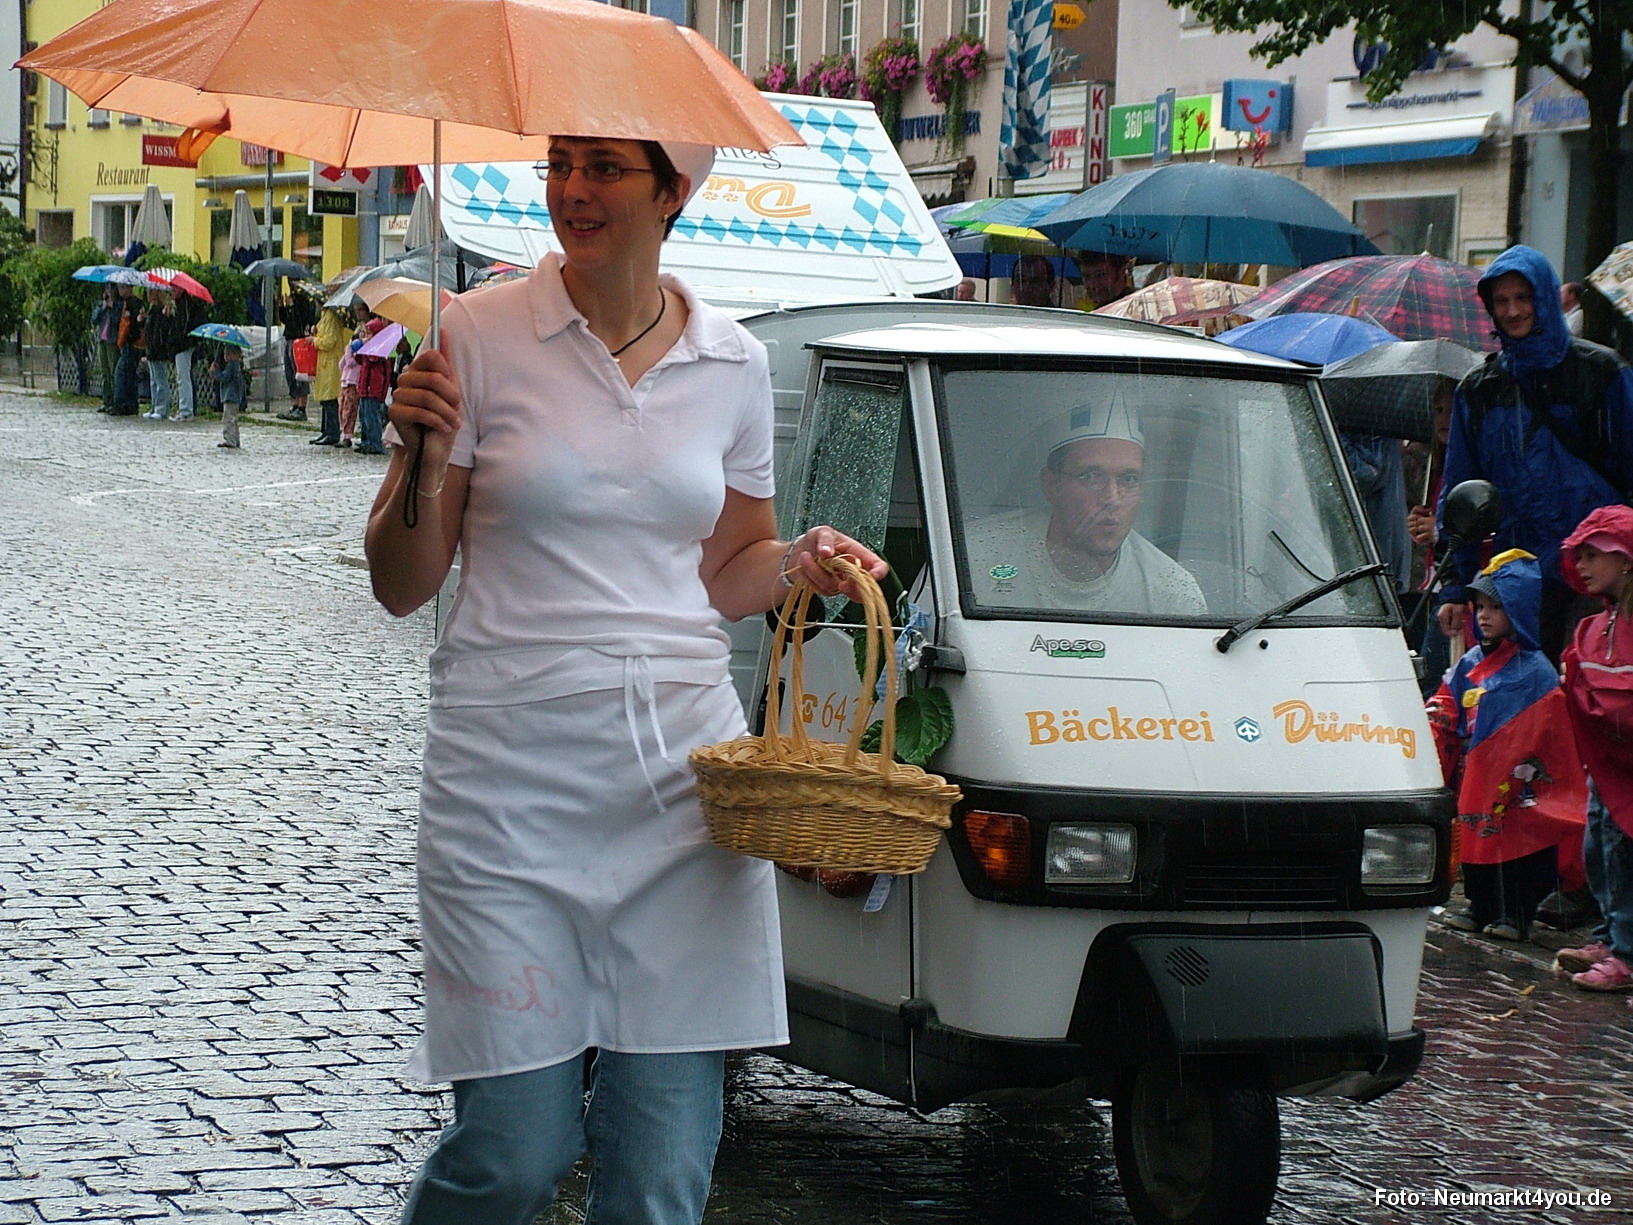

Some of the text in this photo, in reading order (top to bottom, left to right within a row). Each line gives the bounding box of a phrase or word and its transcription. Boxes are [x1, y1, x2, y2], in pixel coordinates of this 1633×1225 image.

[1089, 86, 1104, 185] KINO
[1124, 110, 1143, 139] 360
[145, 143, 176, 157] WISSM
[96, 162, 150, 186] Restaurant
[1024, 699, 1417, 759] Bäckerei Düring
